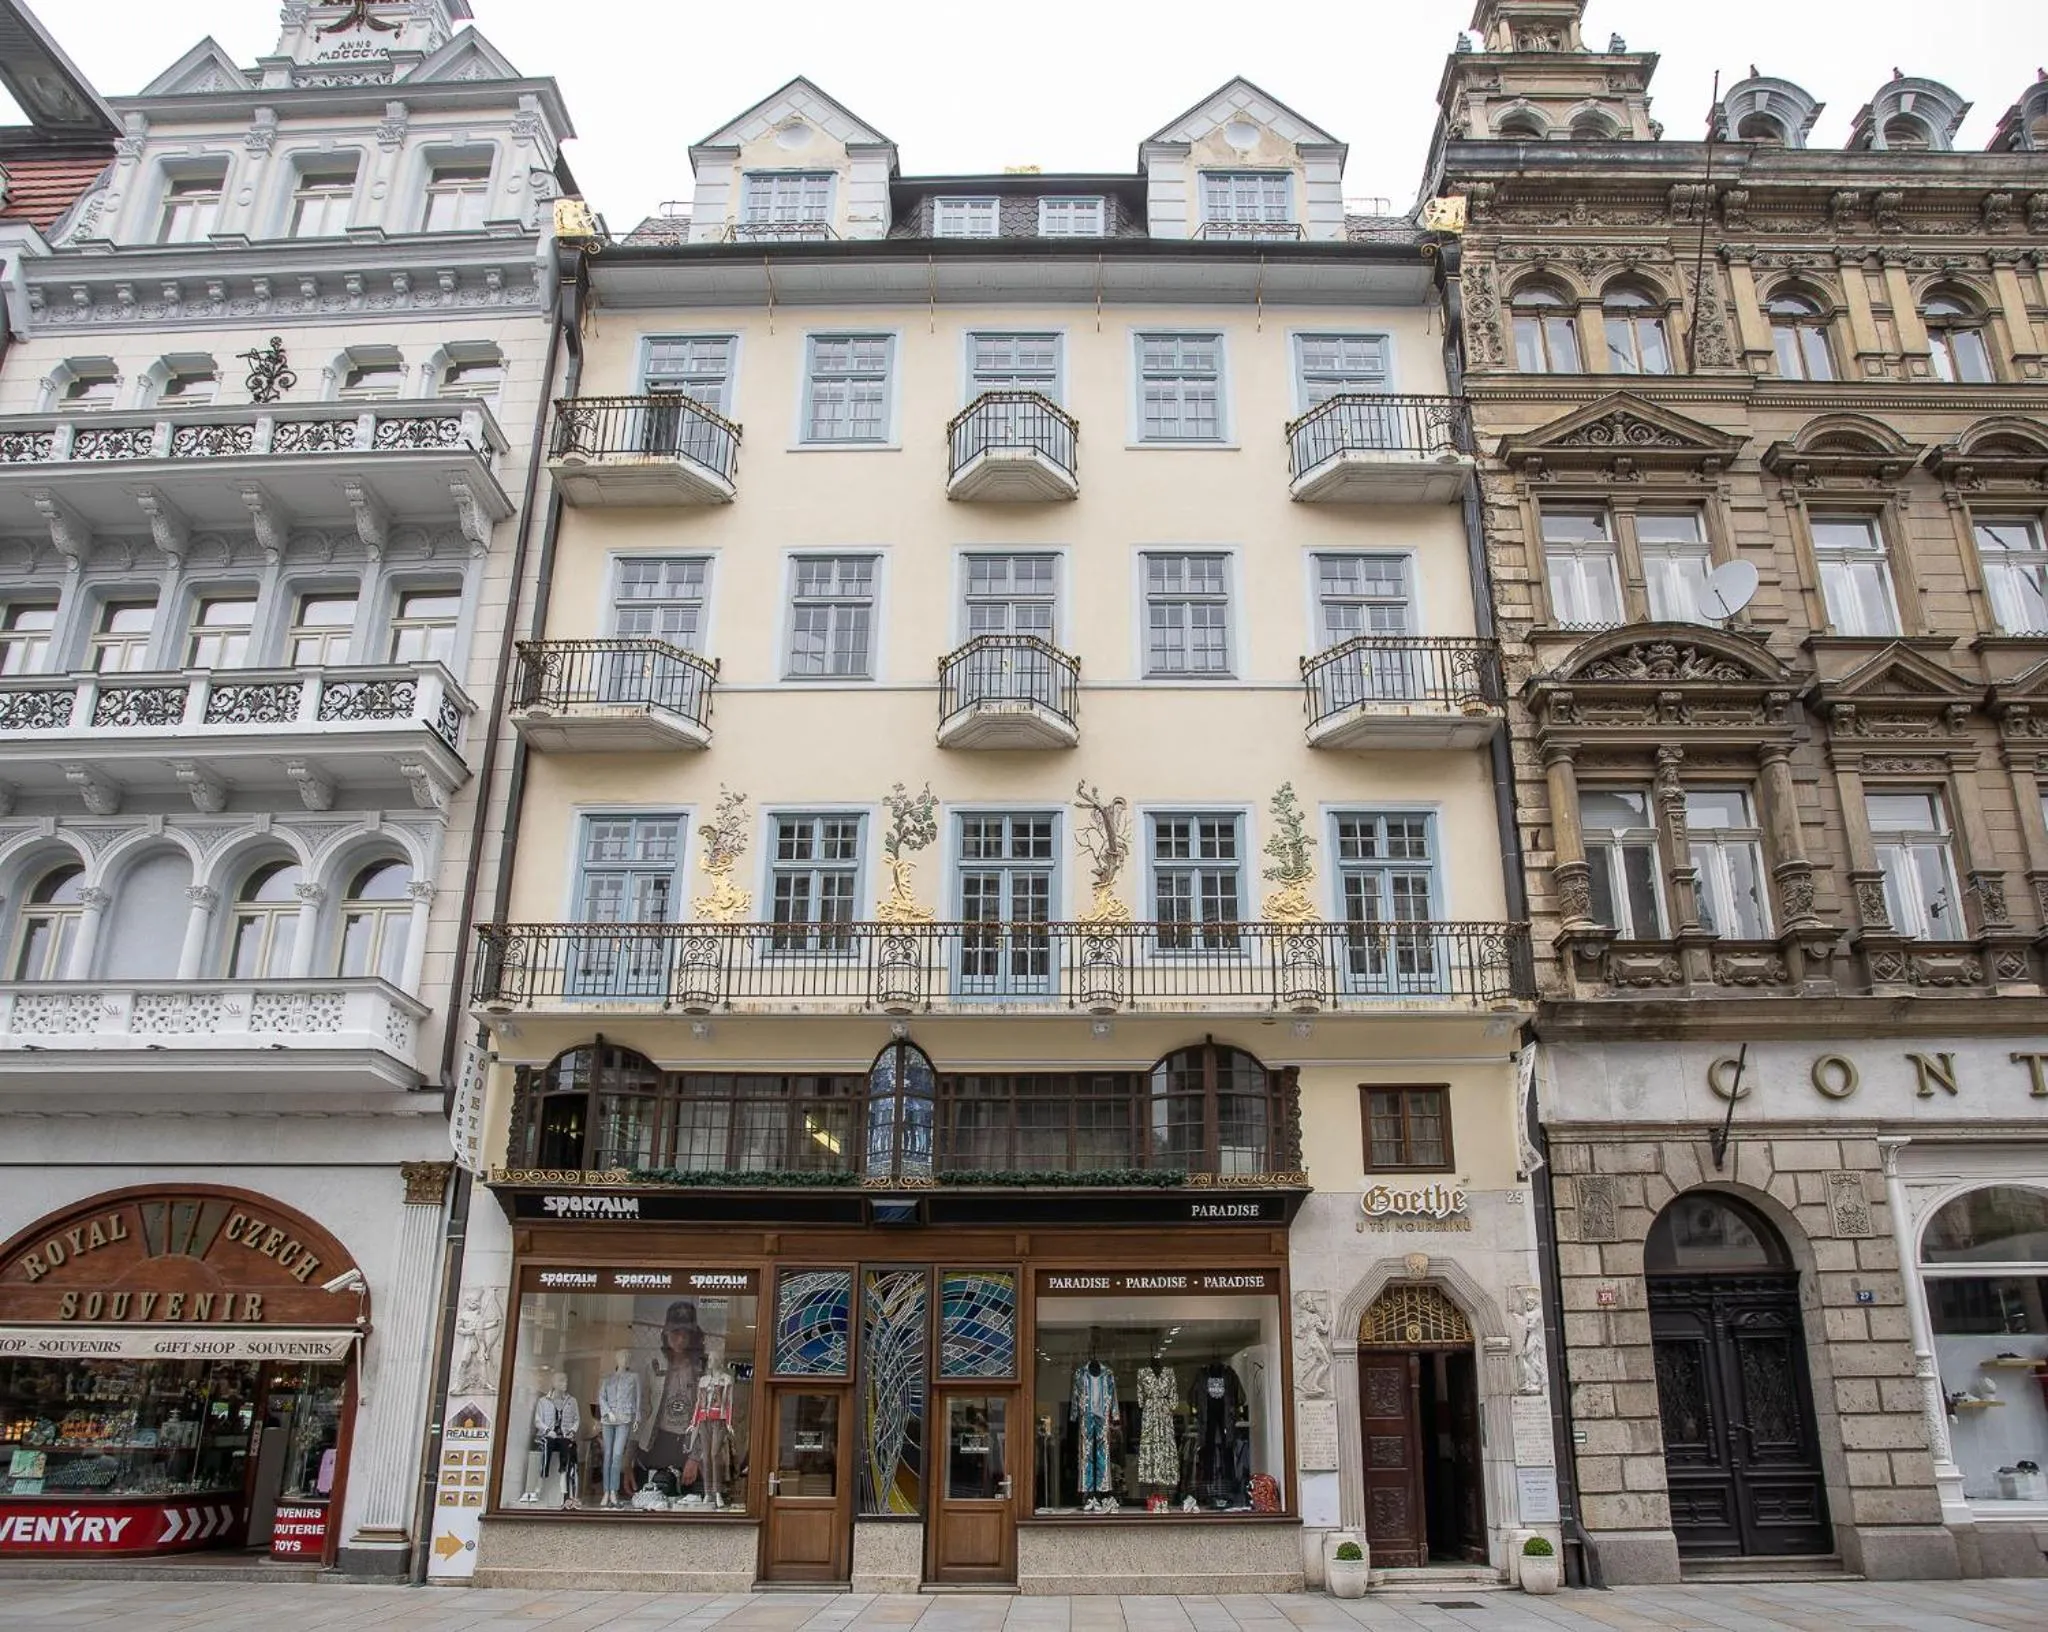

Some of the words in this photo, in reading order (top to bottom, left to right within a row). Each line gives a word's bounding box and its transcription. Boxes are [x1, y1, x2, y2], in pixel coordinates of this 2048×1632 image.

[338, 40, 371, 50] ANNO
[1361, 1183, 1467, 1218] Goethe
[1506, 1191, 1524, 1204] 25
[543, 1196, 639, 1217] SPORTALM
[1191, 1205, 1259, 1216] PARADISE
[18, 1214, 127, 1281] ROYAL
[225, 1214, 320, 1283] CZECH
[540, 1273, 597, 1286] SPORTALM
[614, 1274, 672, 1288] SPORTALM
[689, 1275, 747, 1288] SPORTALM
[1048, 1277, 1110, 1289] PARADISE
[1126, 1277, 1187, 1288] PARADISE
[1204, 1276, 1265, 1288] PARADISE
[60, 1291, 263, 1321] SOUVENIR
[38, 1339, 122, 1353] SOUVENIRS
[154, 1341, 192, 1353] GIFT
[193, 1341, 236, 1354] SHOP
[247, 1342, 332, 1355] SOUVENIRS
[446, 1429, 490, 1439] REALLEX
[275, 1540, 302, 1551] TOYS
